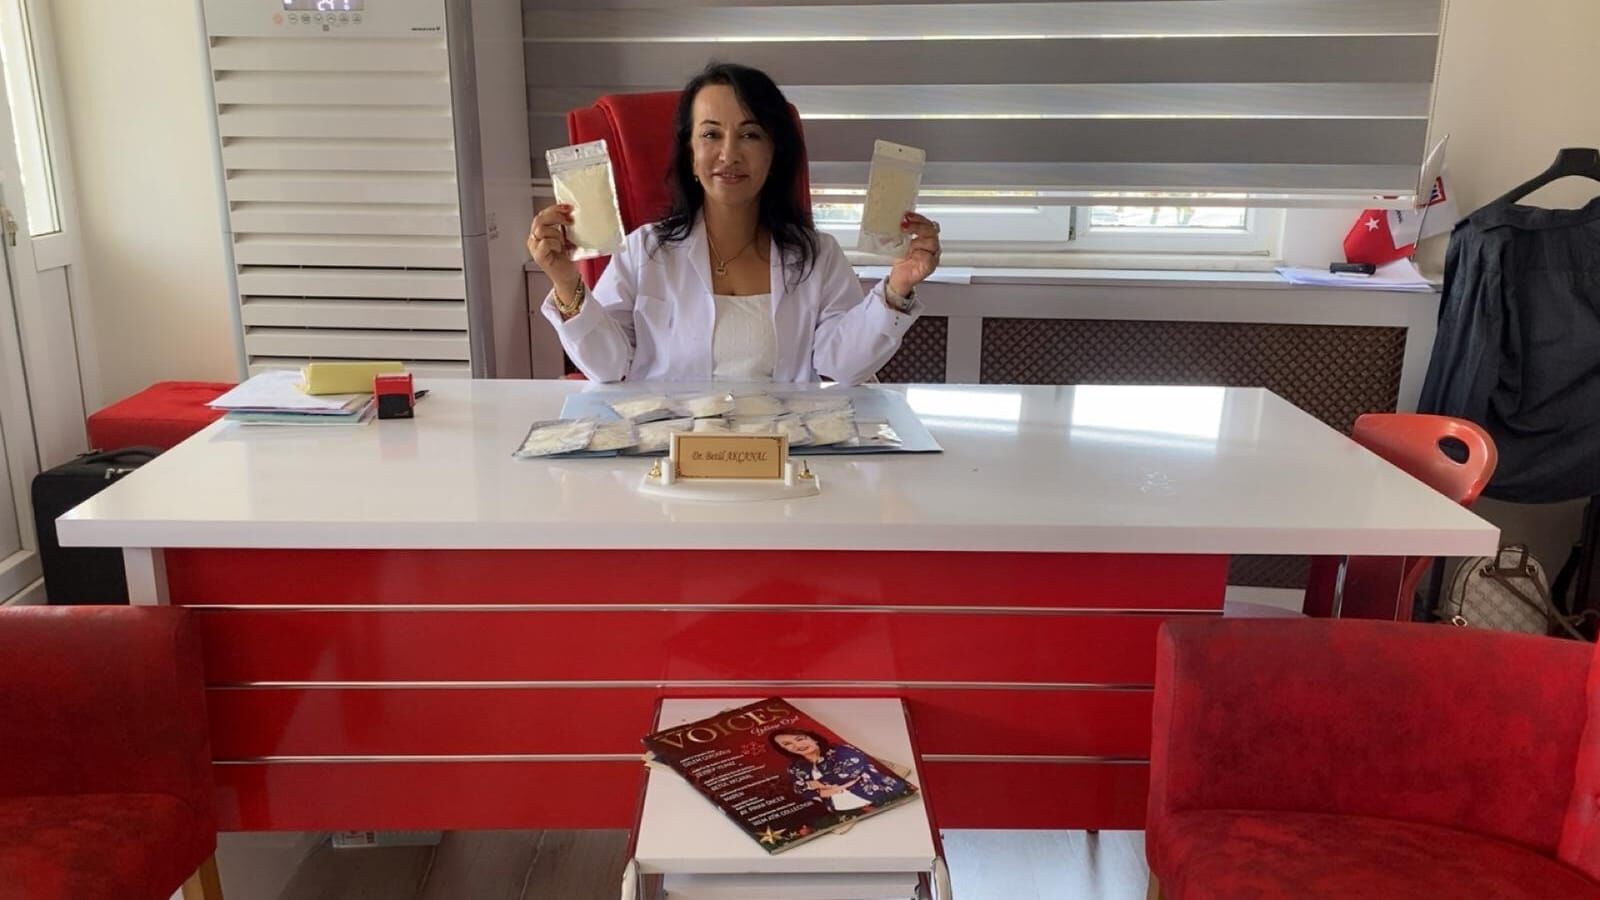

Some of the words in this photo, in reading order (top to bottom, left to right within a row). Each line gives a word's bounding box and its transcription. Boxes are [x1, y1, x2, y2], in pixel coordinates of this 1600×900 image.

[691, 451, 704, 461] Dr.
[726, 450, 768, 463] AKÇANAL
[660, 704, 791, 749] VOICES
